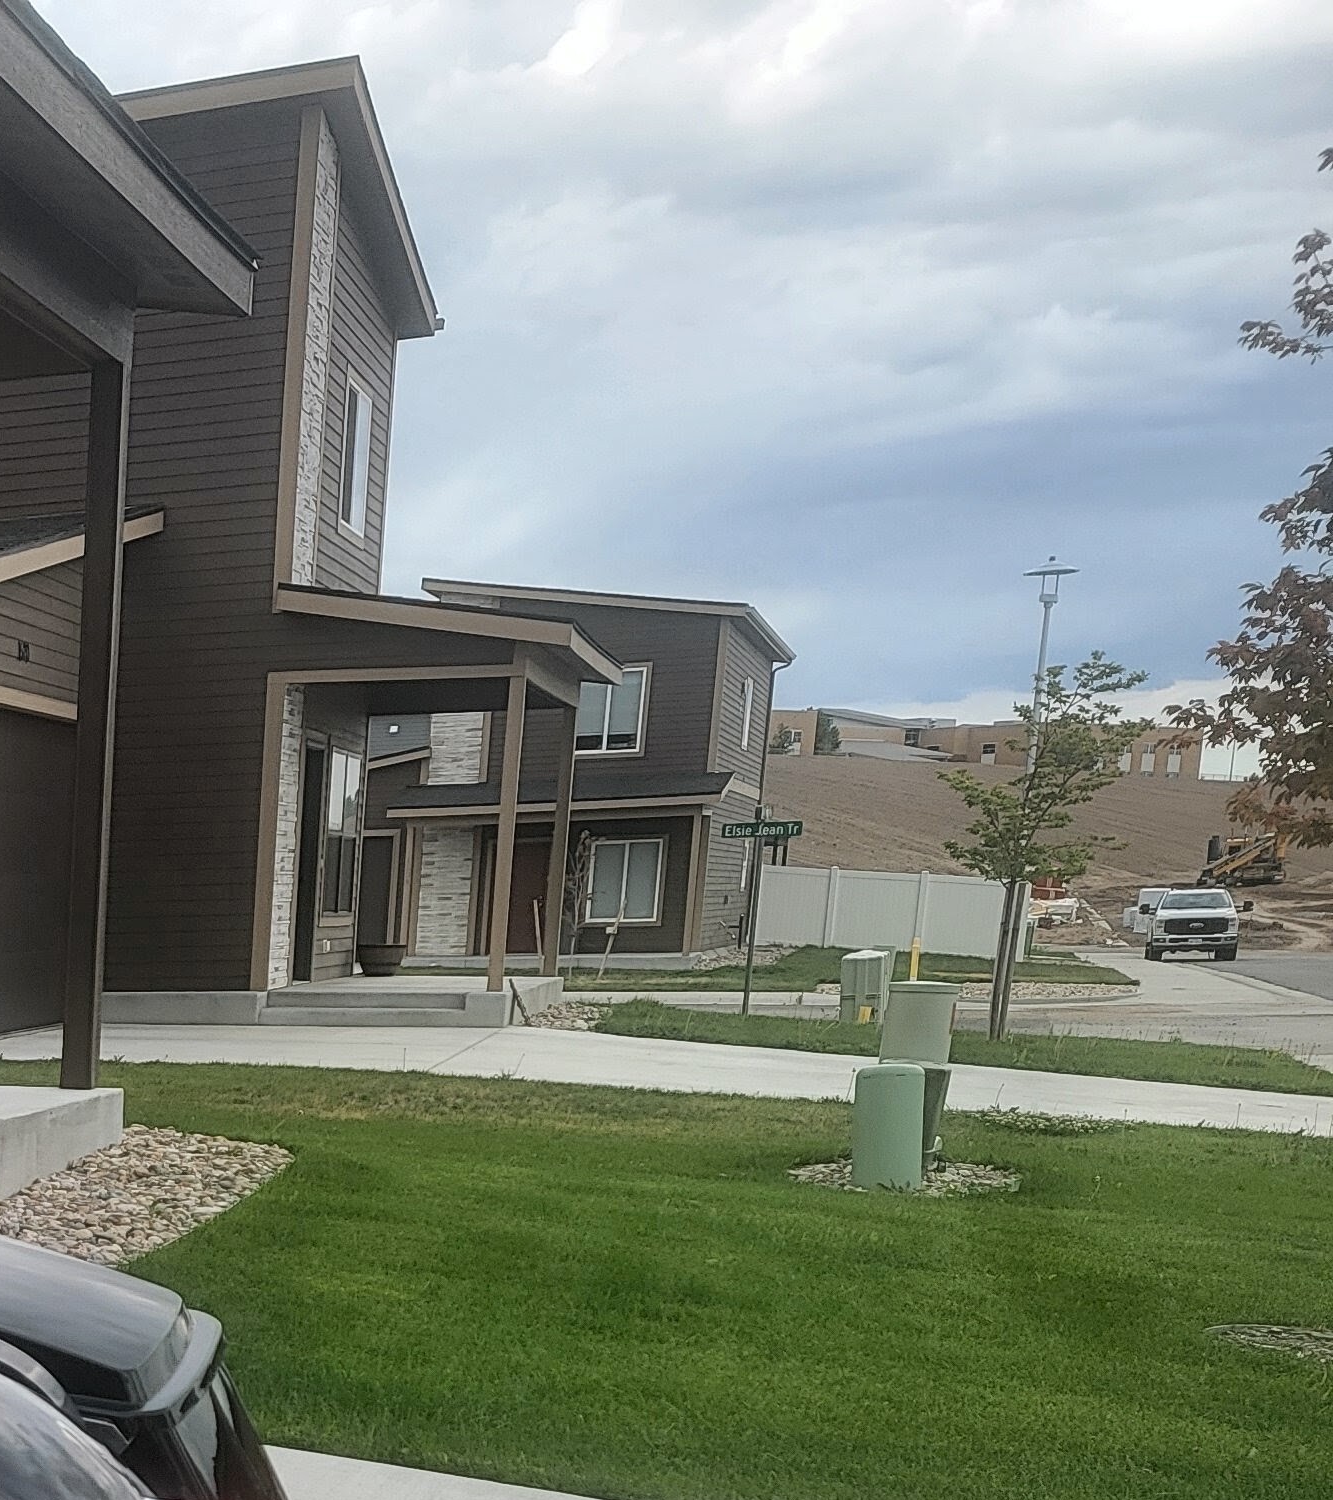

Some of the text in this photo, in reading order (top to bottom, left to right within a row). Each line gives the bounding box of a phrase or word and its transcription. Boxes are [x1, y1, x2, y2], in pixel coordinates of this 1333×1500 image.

[725, 823, 799, 837] Elsie Jean Tr
